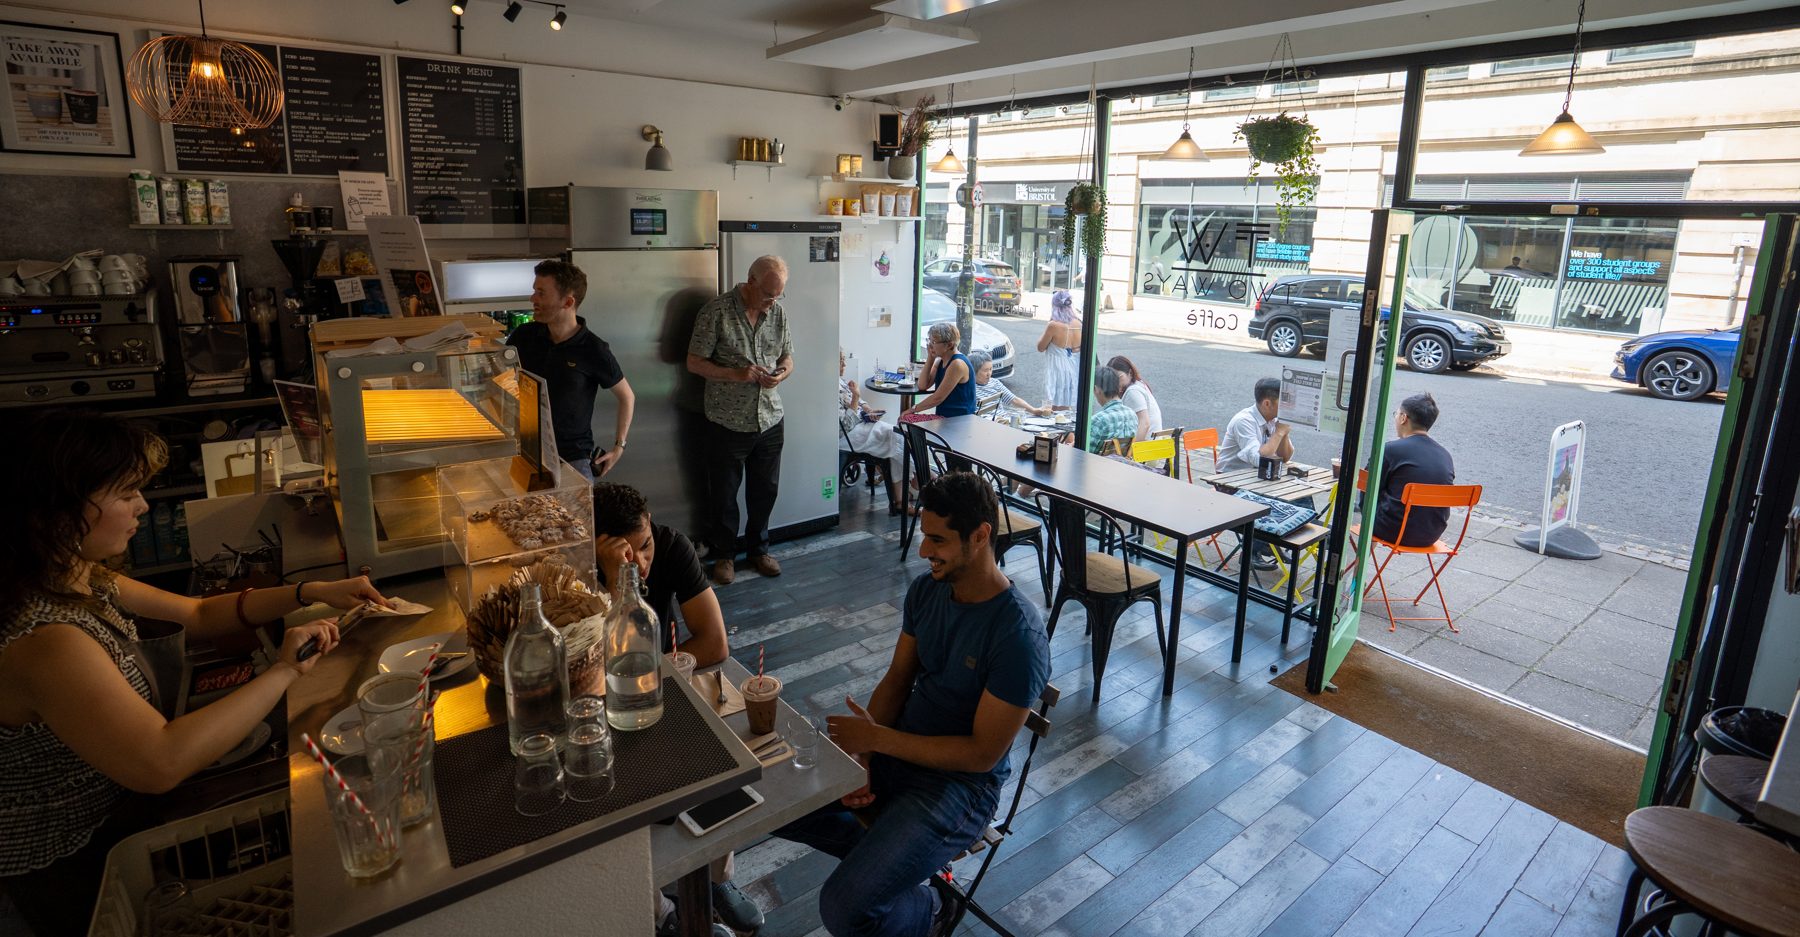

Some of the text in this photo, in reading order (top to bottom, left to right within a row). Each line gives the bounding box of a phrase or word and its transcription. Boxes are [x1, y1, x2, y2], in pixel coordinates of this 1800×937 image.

[6, 42, 80, 58] TAKE AWAY
[8, 53, 81, 66] AVAILABLE
[427, 63, 493, 77] DRINK MENU
[1028, 192, 1056, 201] BRISTOL
[1632, 261, 1661, 269] groups
